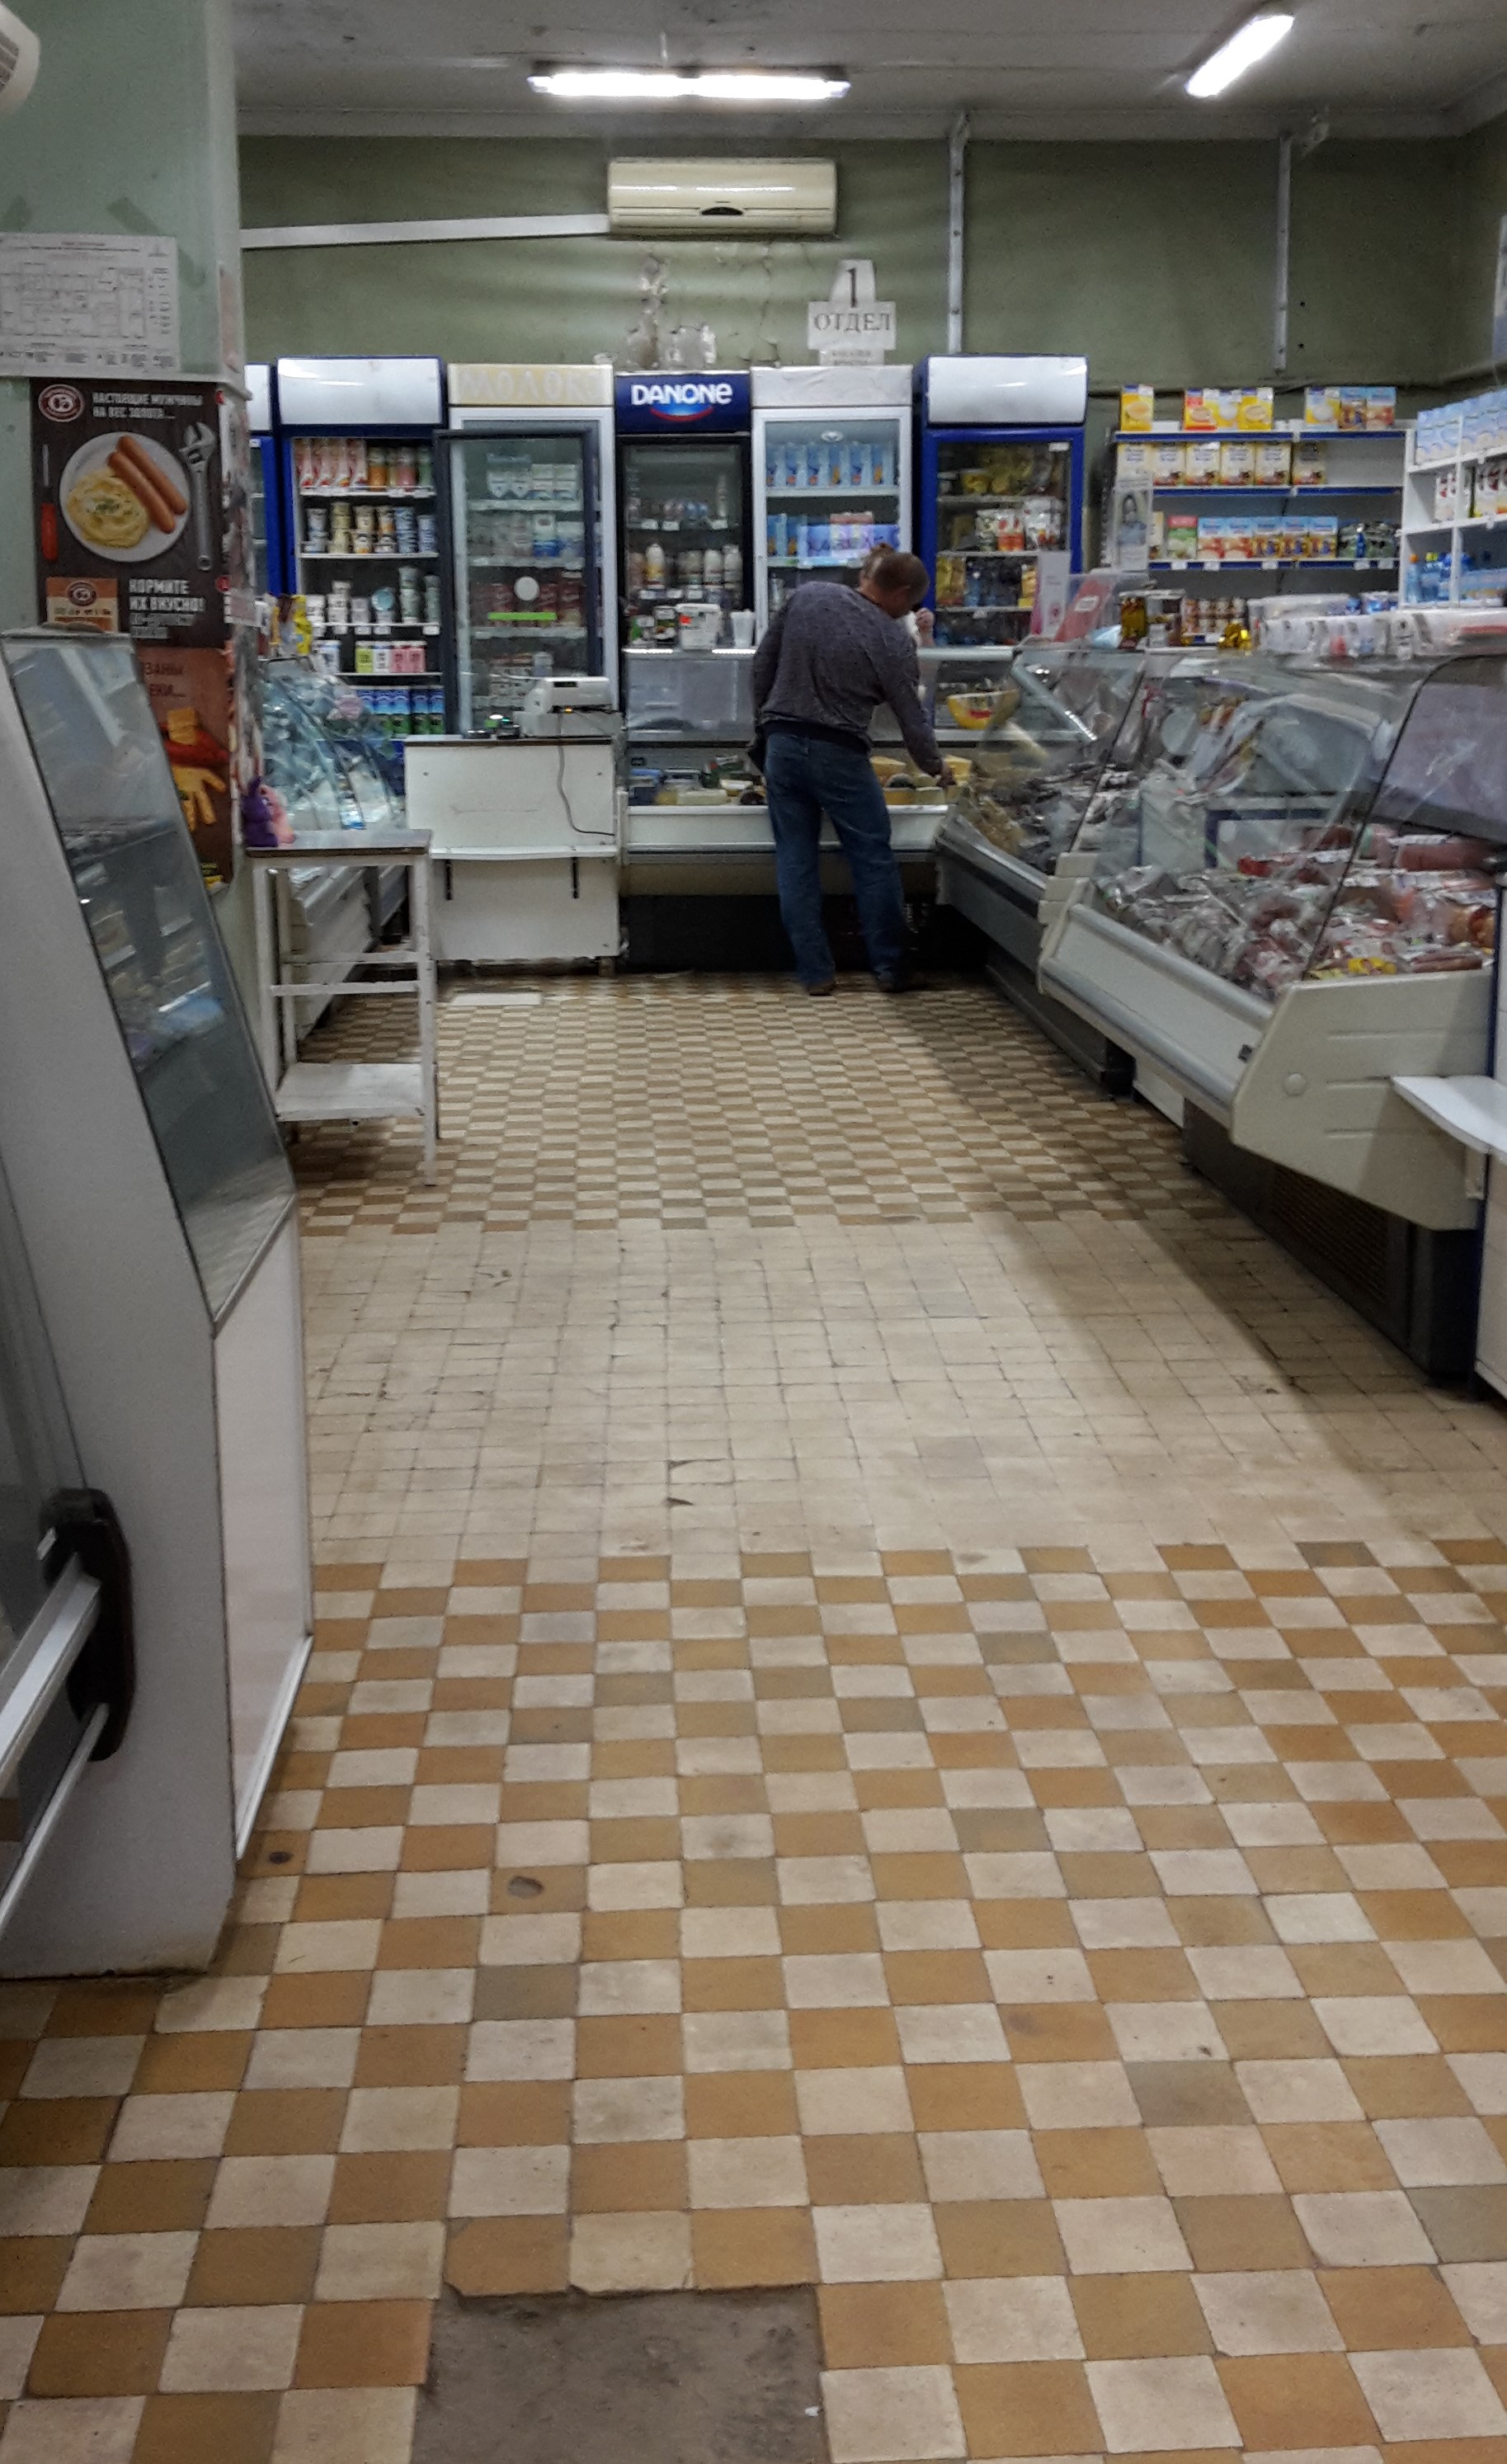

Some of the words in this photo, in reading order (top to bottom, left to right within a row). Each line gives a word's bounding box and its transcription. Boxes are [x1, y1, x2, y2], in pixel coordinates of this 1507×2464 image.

[845, 267, 858, 309] 1
[814, 313, 890, 333] ОТДЕЛ
[129, 578, 191, 595] КОРМИТЕ
[129, 596, 148, 611] ИХ
[149, 596, 205, 612] ВКУСНО!
